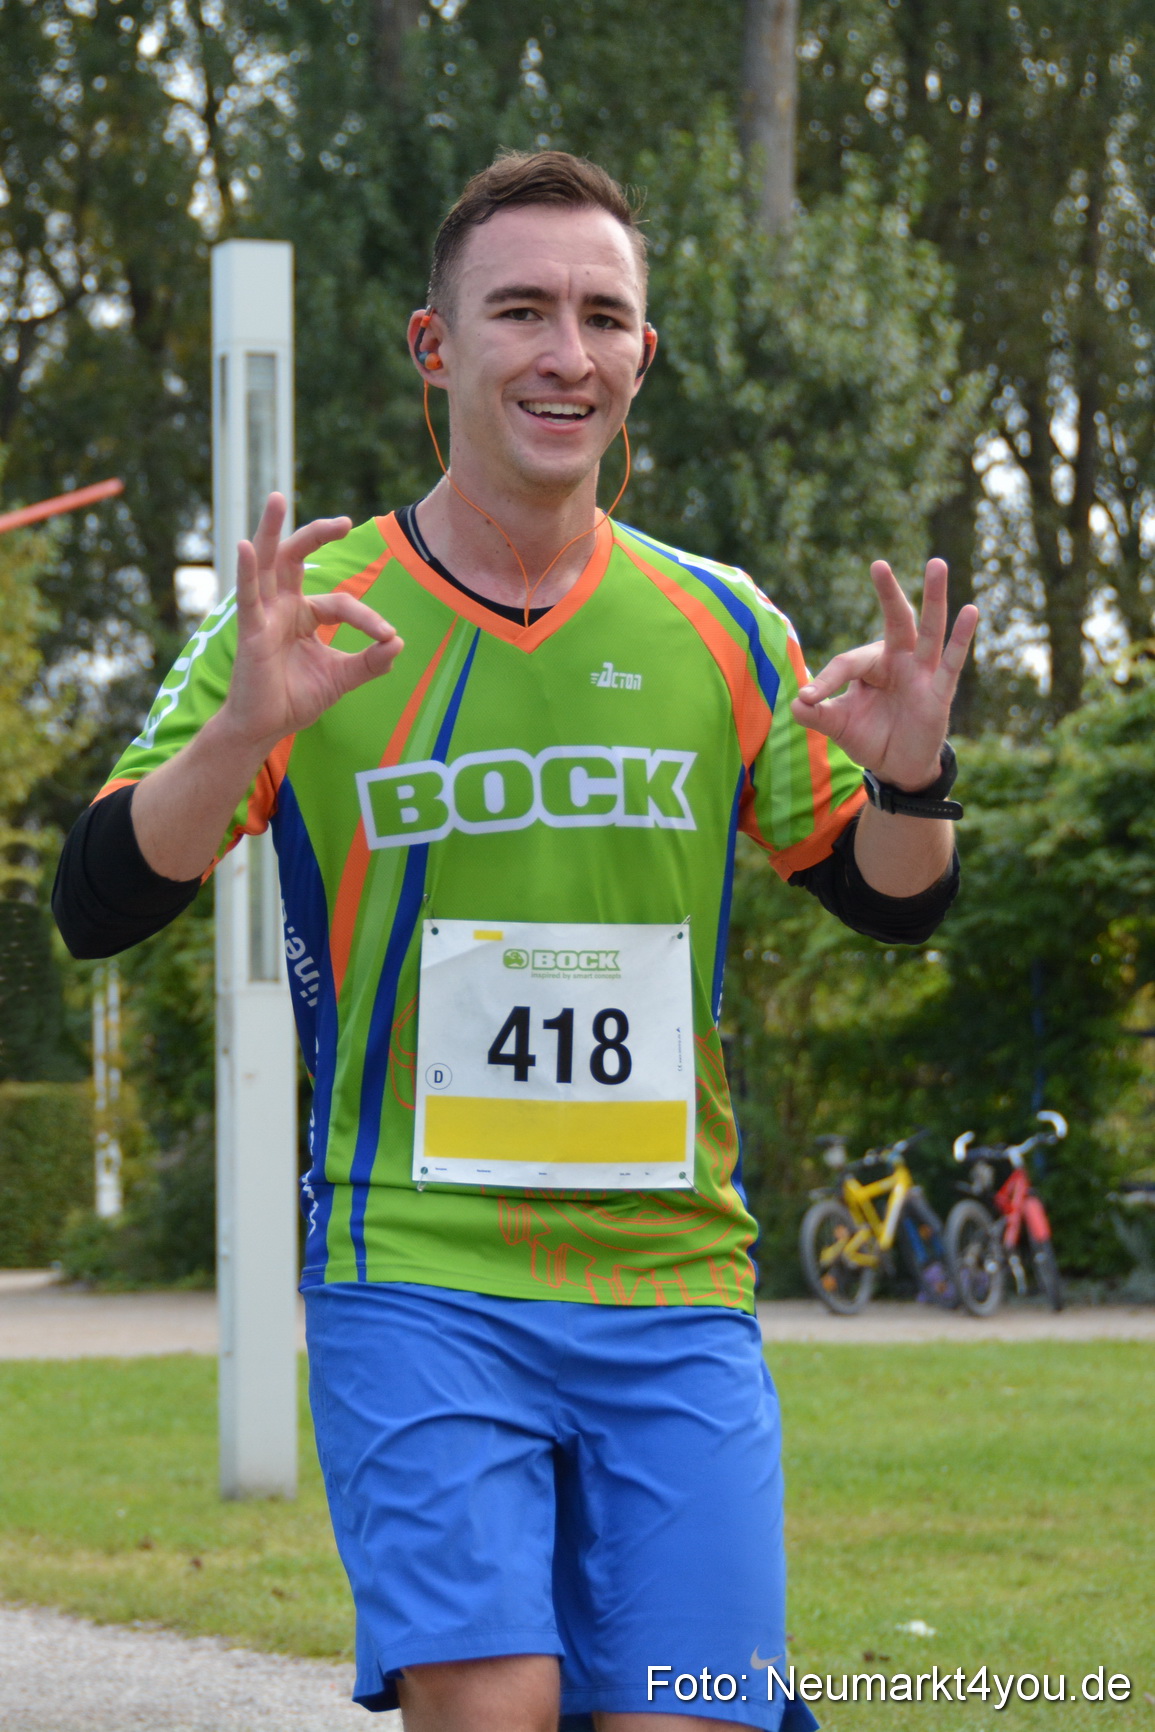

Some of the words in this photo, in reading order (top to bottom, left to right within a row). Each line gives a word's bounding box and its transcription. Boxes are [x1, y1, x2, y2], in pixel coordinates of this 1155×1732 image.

[355, 745, 698, 851] BOCK
[531, 949, 621, 972] BOCK
[531, 972, 561, 980] inspired
[487, 1005, 633, 1086] 418
[434, 1070, 444, 1084] D
